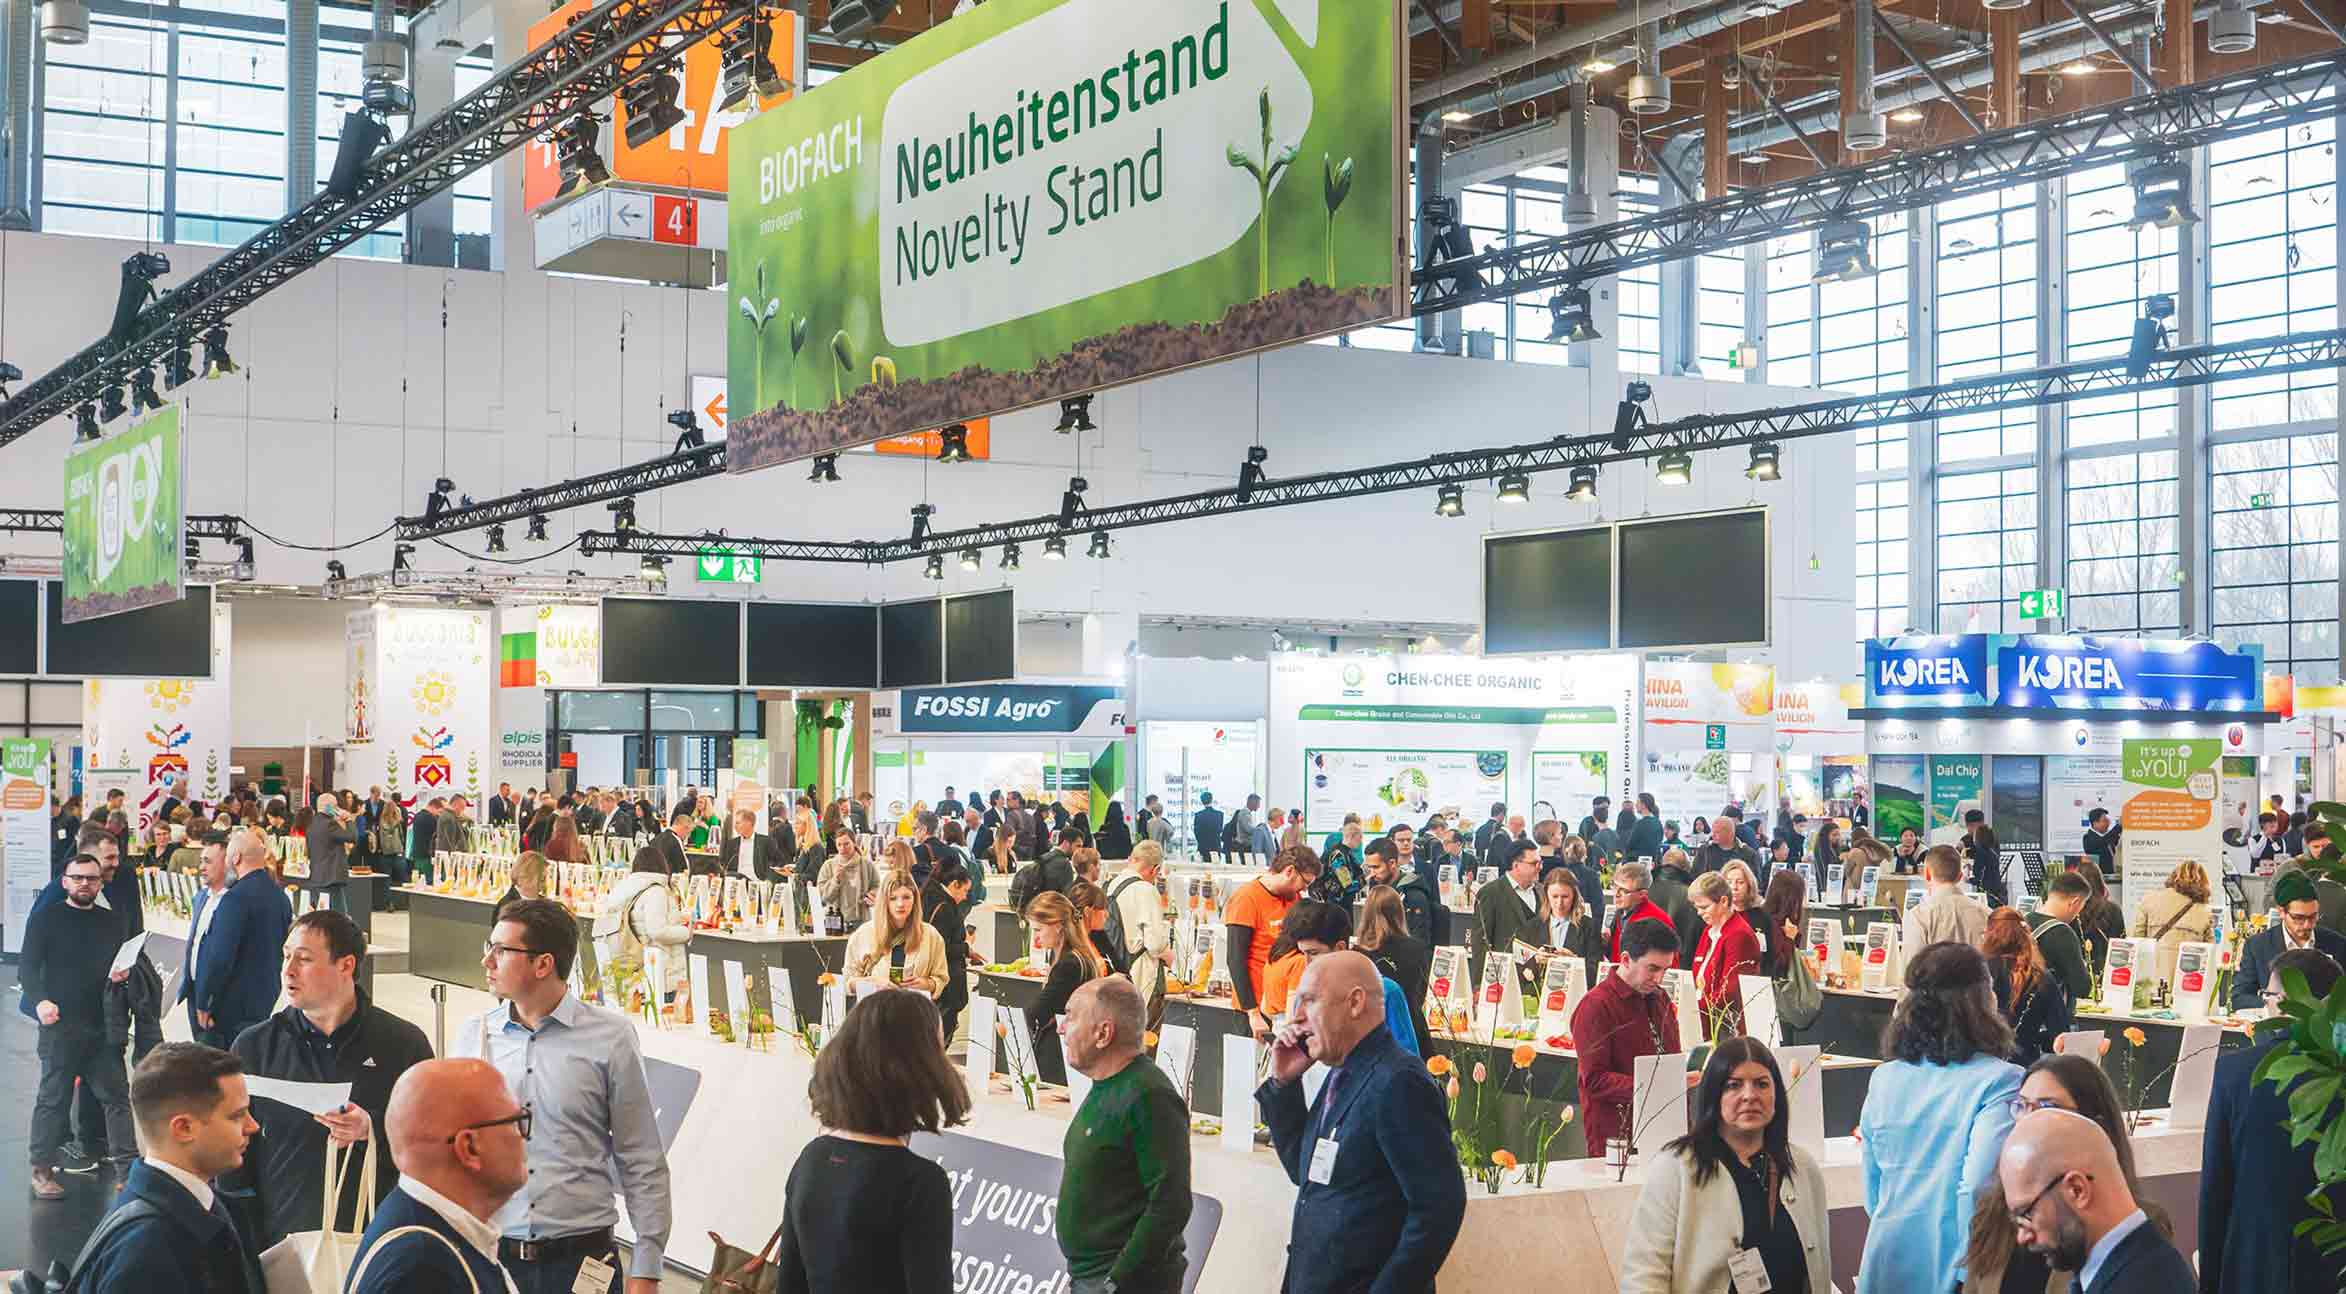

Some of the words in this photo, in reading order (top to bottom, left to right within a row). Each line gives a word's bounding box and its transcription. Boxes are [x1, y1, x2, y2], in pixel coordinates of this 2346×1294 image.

[896, 0, 1229, 204] Neuheitenstand
[759, 113, 863, 206] BIOFACH
[667, 205, 683, 236] 4
[896, 193, 1031, 286] Novelty
[1047, 127, 1163, 235] Stand
[1386, 672, 1473, 687] CHEN-CHEE
[1477, 674, 1543, 690] ORGANIC
[1880, 656, 1970, 688] KOREA
[2017, 653, 2124, 691] KOREA
[914, 695, 990, 718] FOSSI
[1777, 692, 1809, 710] INA
[503, 730, 543, 746] elpis
[2140, 746, 2159, 758] It's
[2160, 747, 2176, 760] up
[1936, 765, 1954, 777] Dal
[1956, 764, 1979, 778] Chip
[961, 1177, 1059, 1240] yours
